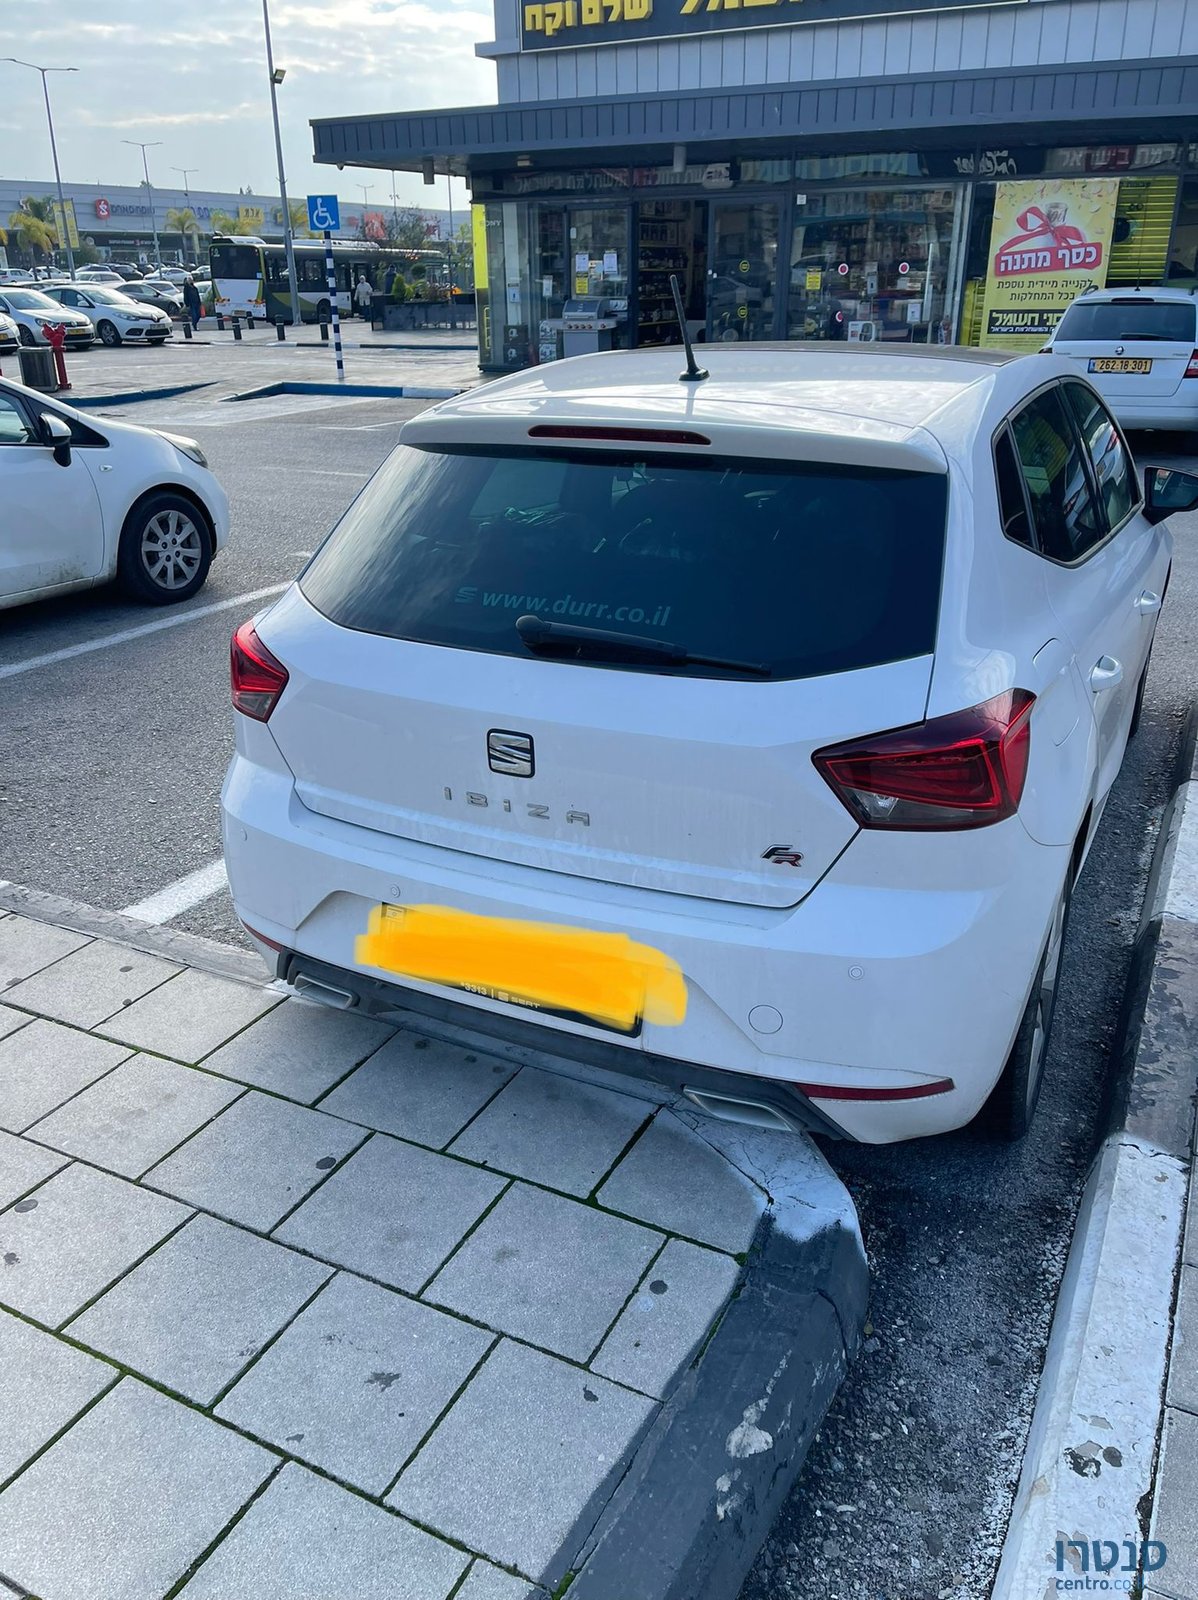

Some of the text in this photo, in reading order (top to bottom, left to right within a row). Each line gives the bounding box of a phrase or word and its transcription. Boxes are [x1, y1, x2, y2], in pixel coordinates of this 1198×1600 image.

[525, 1, 576, 36] וקח
[1000, 246, 1097, 273] כסף מתנה
[997, 281, 1025, 291] נוספת
[1010, 290, 1076, 302] בכל המחלקות
[1061, 278, 1093, 290] לקנייה
[992, 312, 1064, 326] סני חשמל
[481, 590, 671, 627] www.durr.co.il
[443, 786, 591, 827] IBIZA
[760, 843, 804, 868] FR
